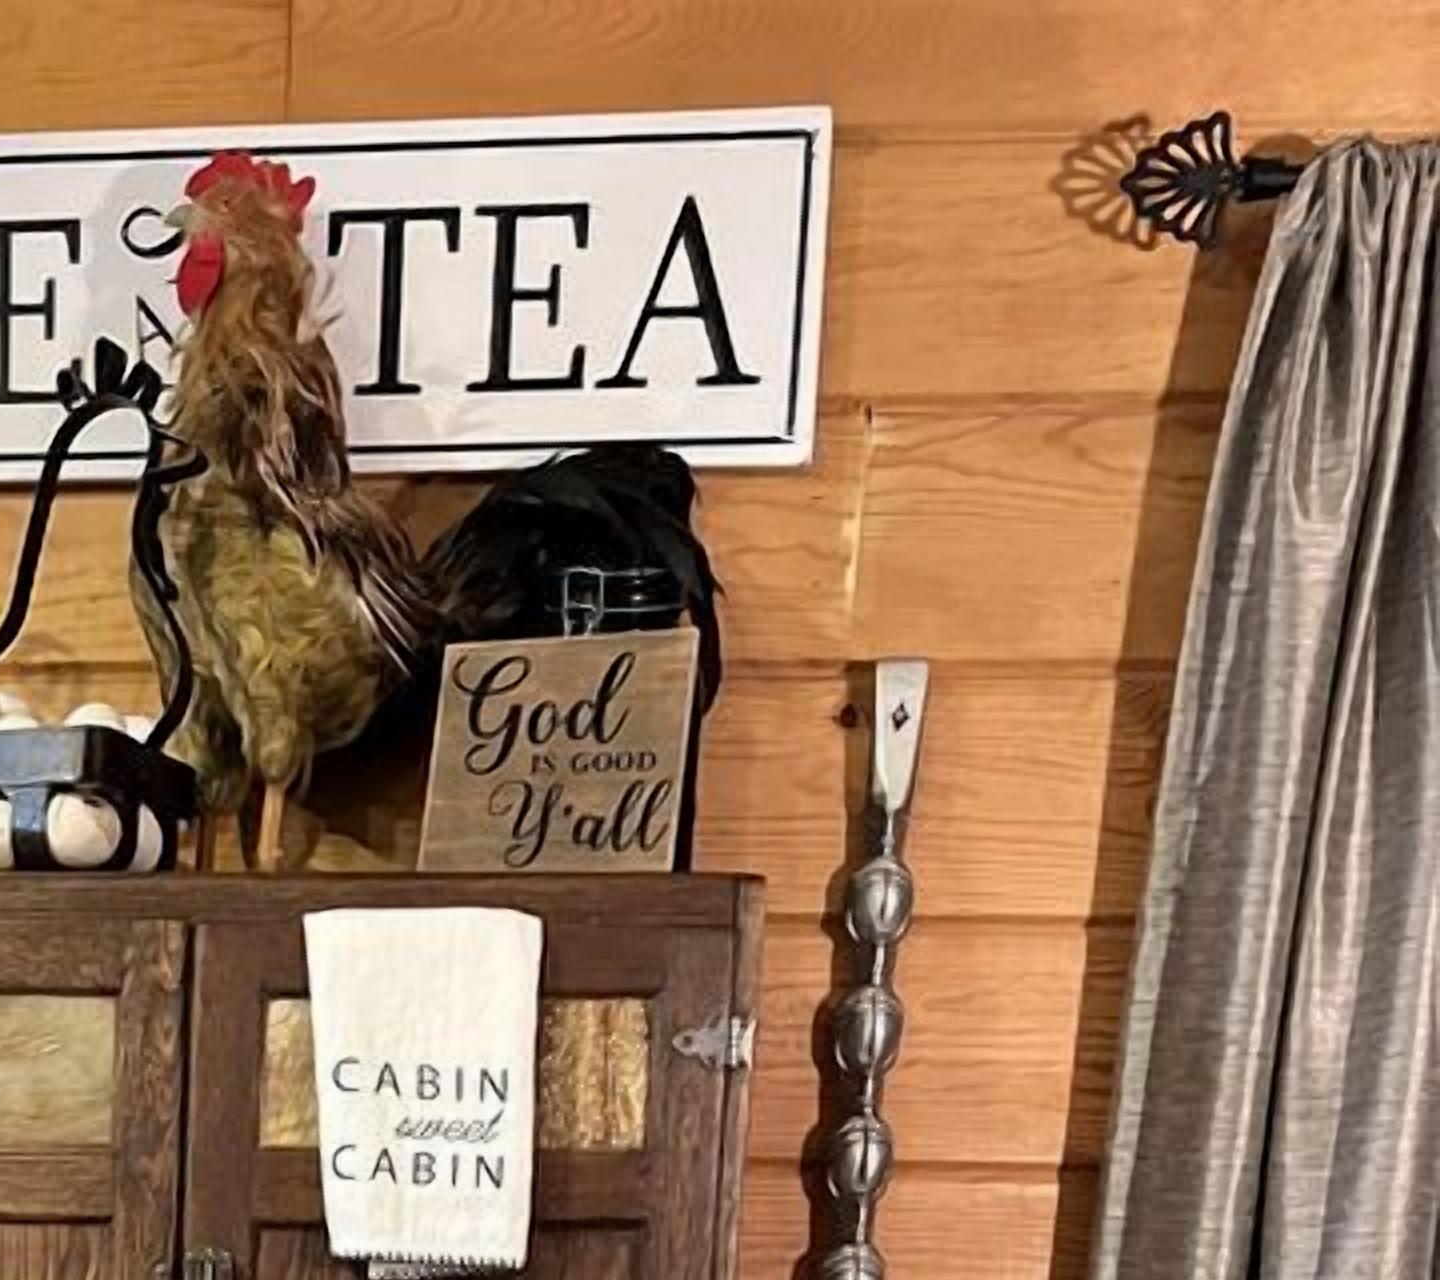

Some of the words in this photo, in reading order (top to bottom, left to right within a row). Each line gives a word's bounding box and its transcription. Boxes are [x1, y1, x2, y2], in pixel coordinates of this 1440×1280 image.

[327, 195, 760, 395] TEA
[452, 652, 637, 776] God
[571, 751, 657, 773] GOOD
[488, 780, 673, 869] Y'all
[332, 1056, 510, 1103] CABIN
[332, 1144, 506, 1190] CABIN
